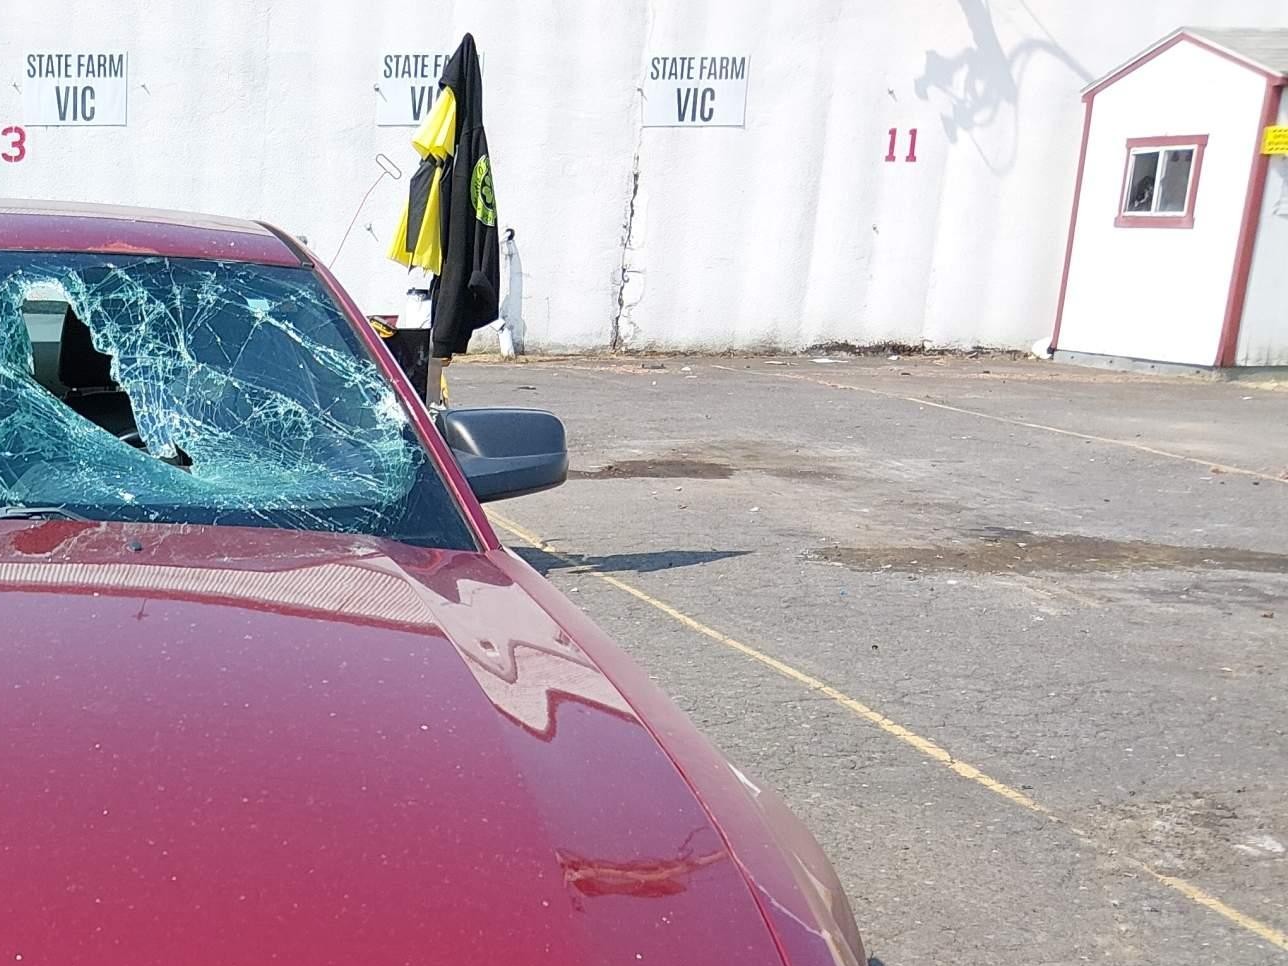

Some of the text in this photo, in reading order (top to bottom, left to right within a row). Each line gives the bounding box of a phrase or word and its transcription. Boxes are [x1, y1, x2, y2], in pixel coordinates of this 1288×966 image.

[26, 54, 123, 78] STATE FARM
[383, 54, 429, 79] STATE
[650, 56, 746, 80] STATE FARM
[55, 86, 96, 121] VIC
[410, 86, 441, 121] VI
[676, 87, 715, 122] VIC
[884, 127, 918, 162] 11
